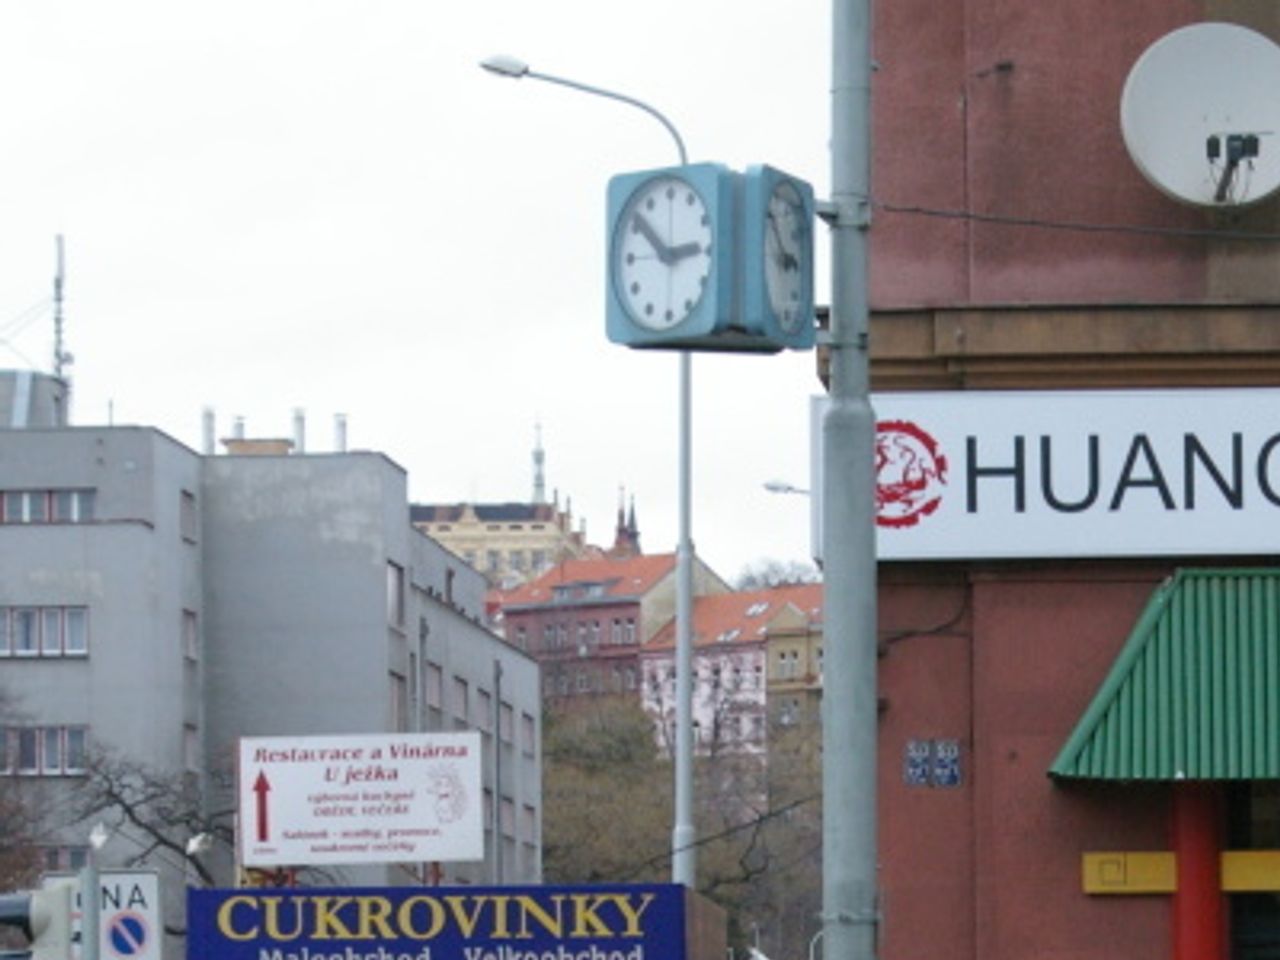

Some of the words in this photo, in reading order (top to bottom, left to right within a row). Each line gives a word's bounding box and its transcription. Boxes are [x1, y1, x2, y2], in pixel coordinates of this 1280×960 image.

[253, 747, 364, 763] Restaurace
[370, 750, 383, 760] a
[216, 892, 656, 941] CUKROVINKY
